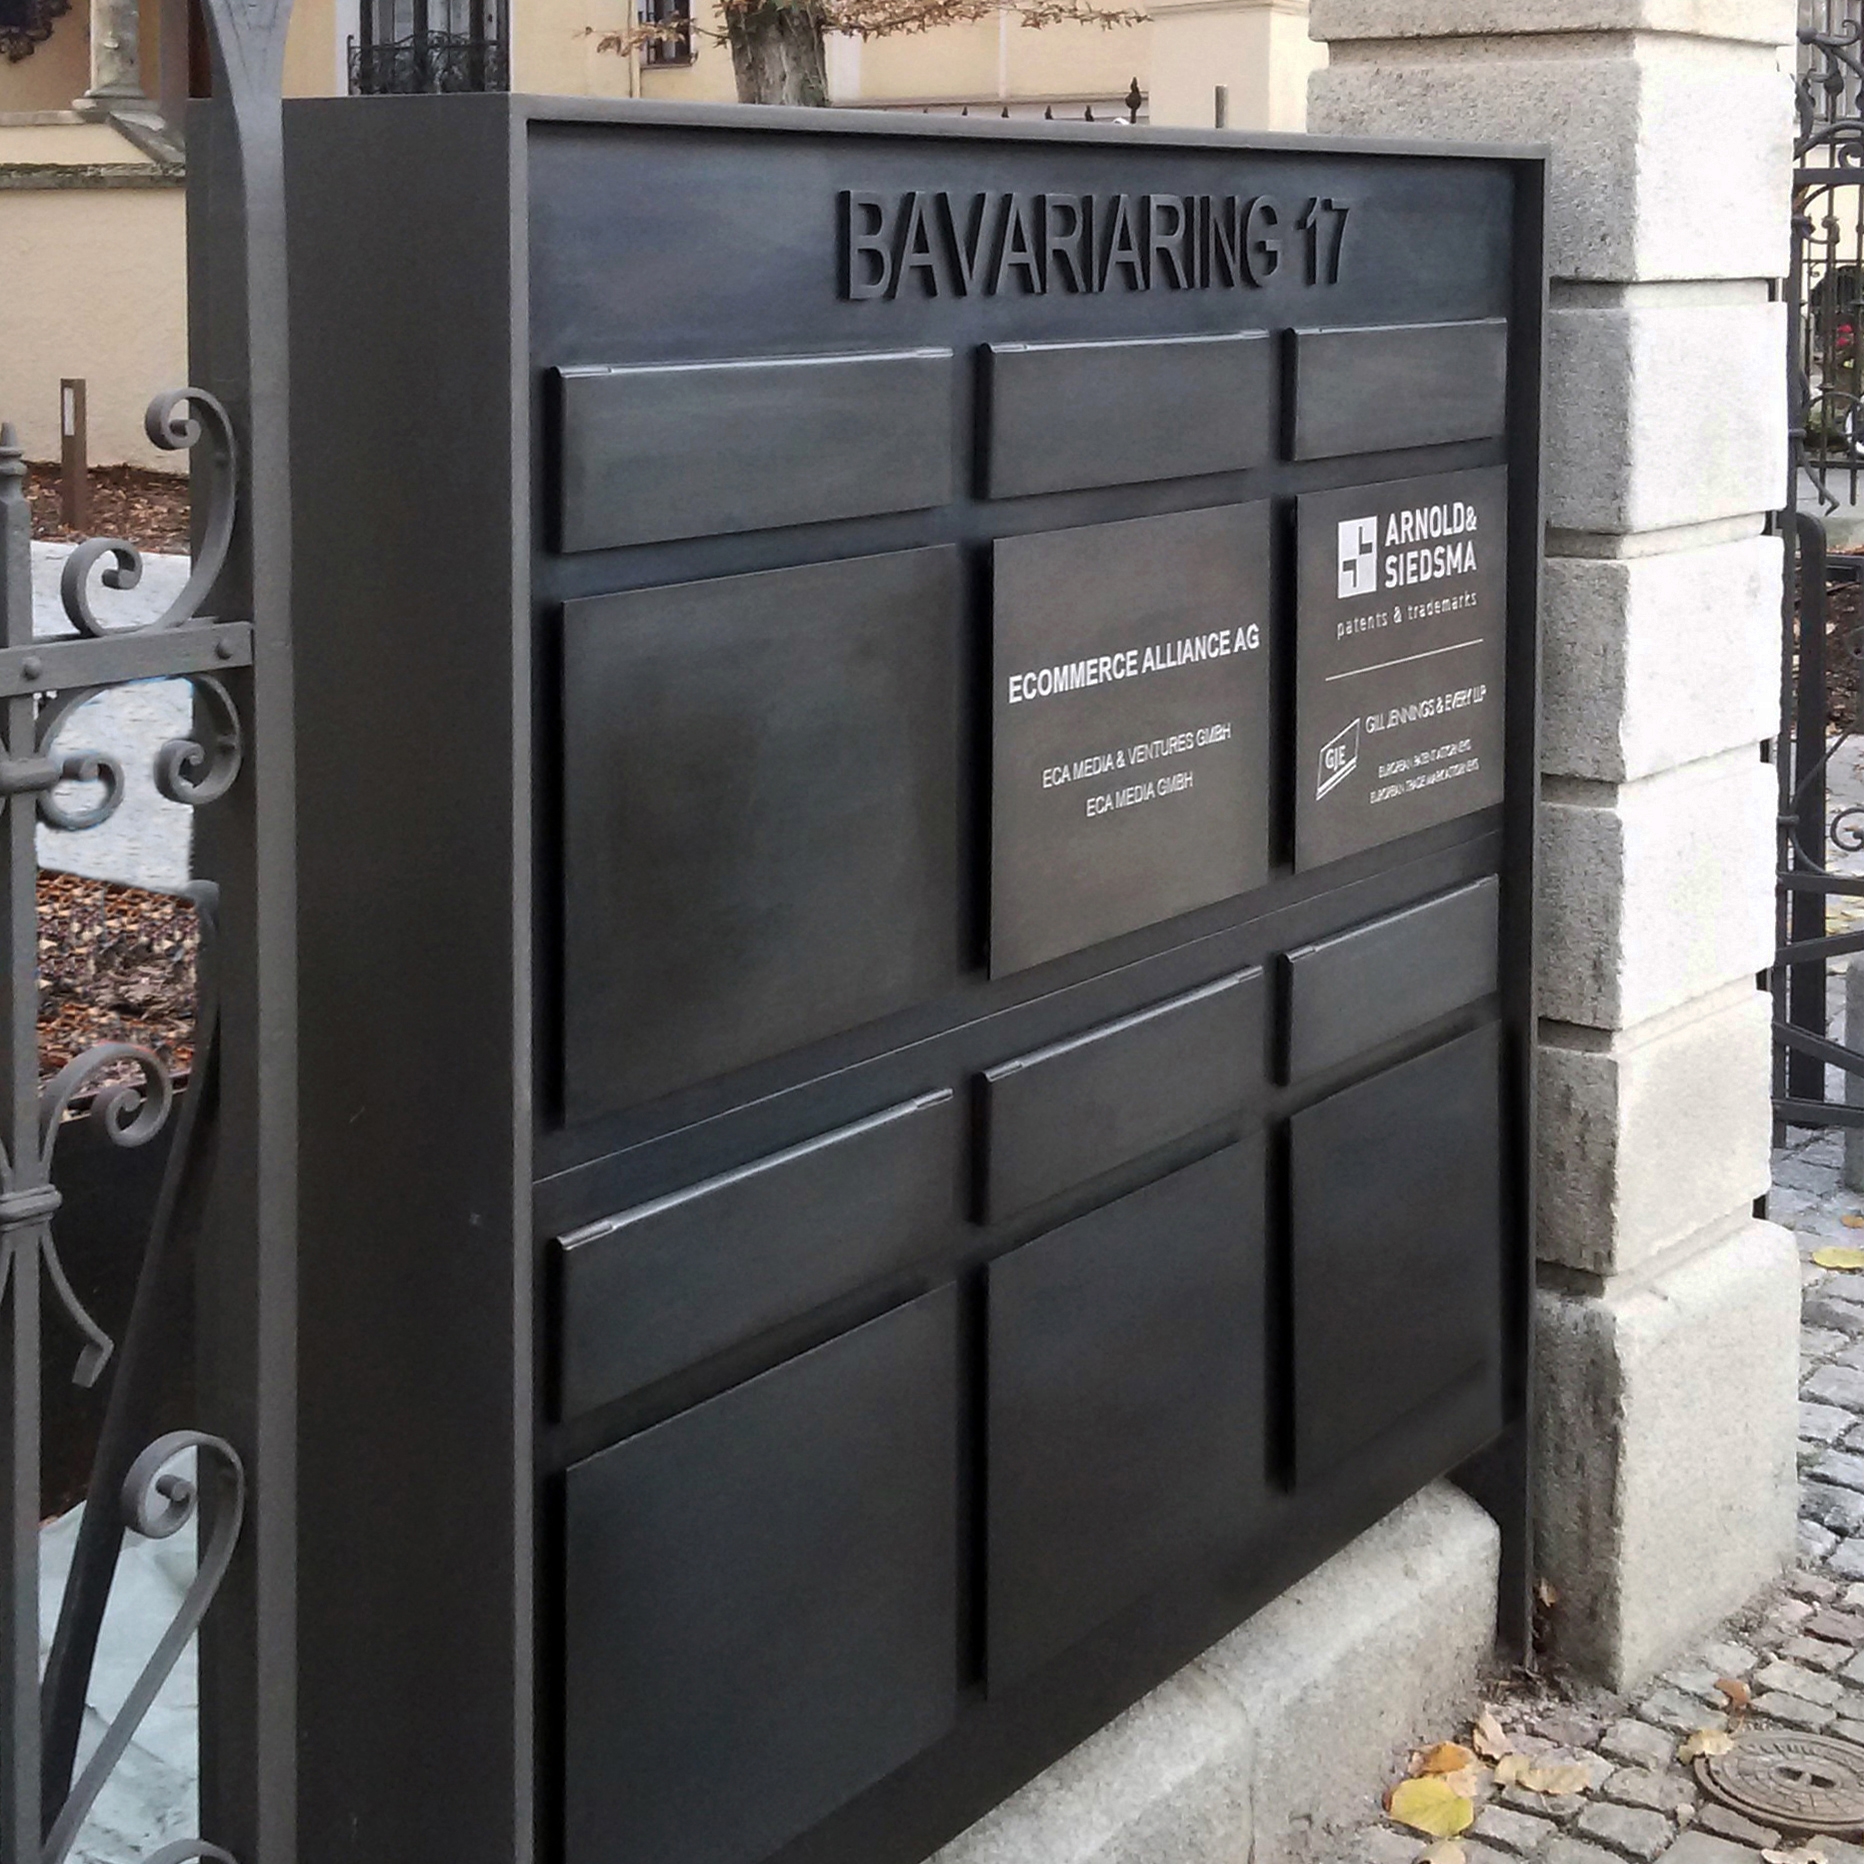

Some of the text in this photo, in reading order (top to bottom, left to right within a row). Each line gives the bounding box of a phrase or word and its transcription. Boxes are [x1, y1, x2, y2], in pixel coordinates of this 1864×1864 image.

[837, 189, 1350, 301] BAVARIARING 17
[1385, 540, 1477, 589] SIEDSMA
[1337, 590, 1478, 640] patents & trademarks
[1008, 622, 1260, 703] ECOMMERCE ALLIANCE AG
[1436, 696, 1444, 714] &
[1042, 723, 1232, 788] ECA MEDIA & VENTURES GMBH
[1086, 771, 1194, 817] ECA MEDIA GMBH
